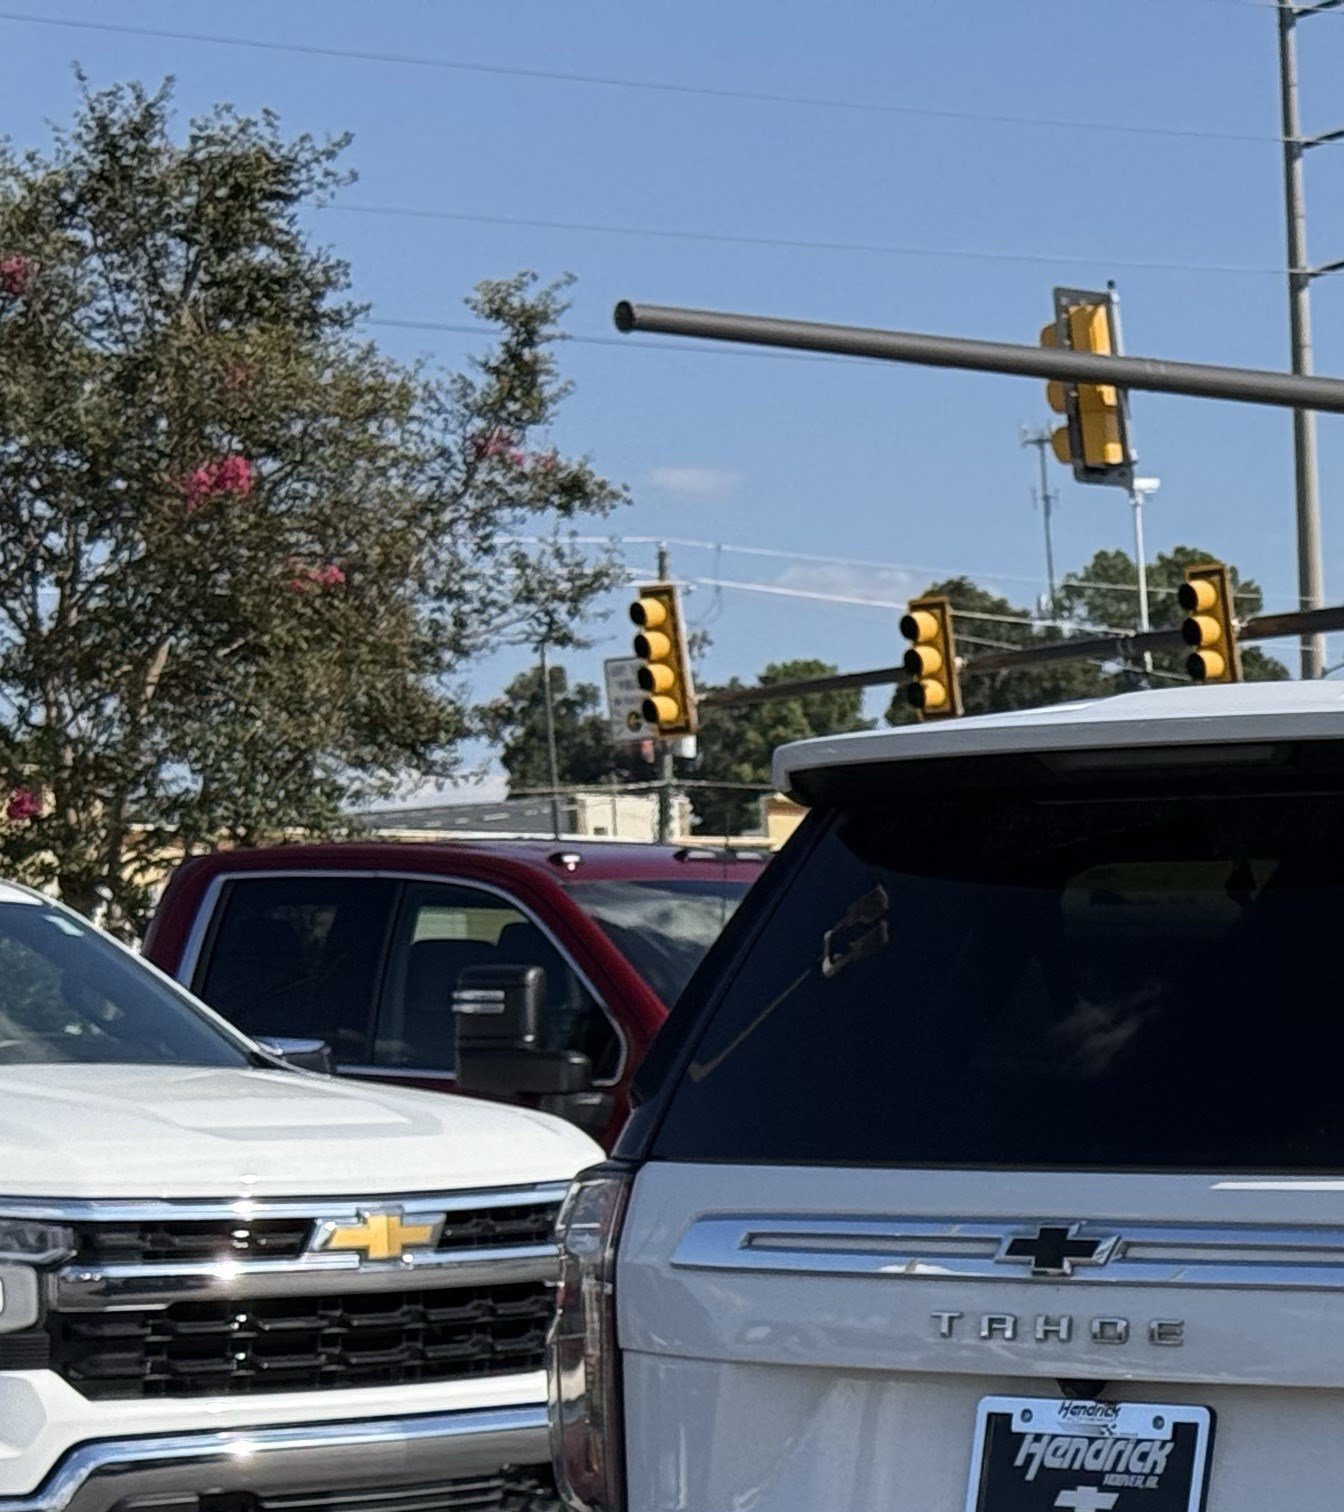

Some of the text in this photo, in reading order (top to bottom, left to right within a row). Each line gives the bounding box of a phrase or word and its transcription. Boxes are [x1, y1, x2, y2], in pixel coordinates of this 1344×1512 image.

[931, 1311, 1185, 1347] TAHOE
[1058, 1401, 1121, 1420] Hendrick
[1013, 1433, 1174, 1481] Hendrick
